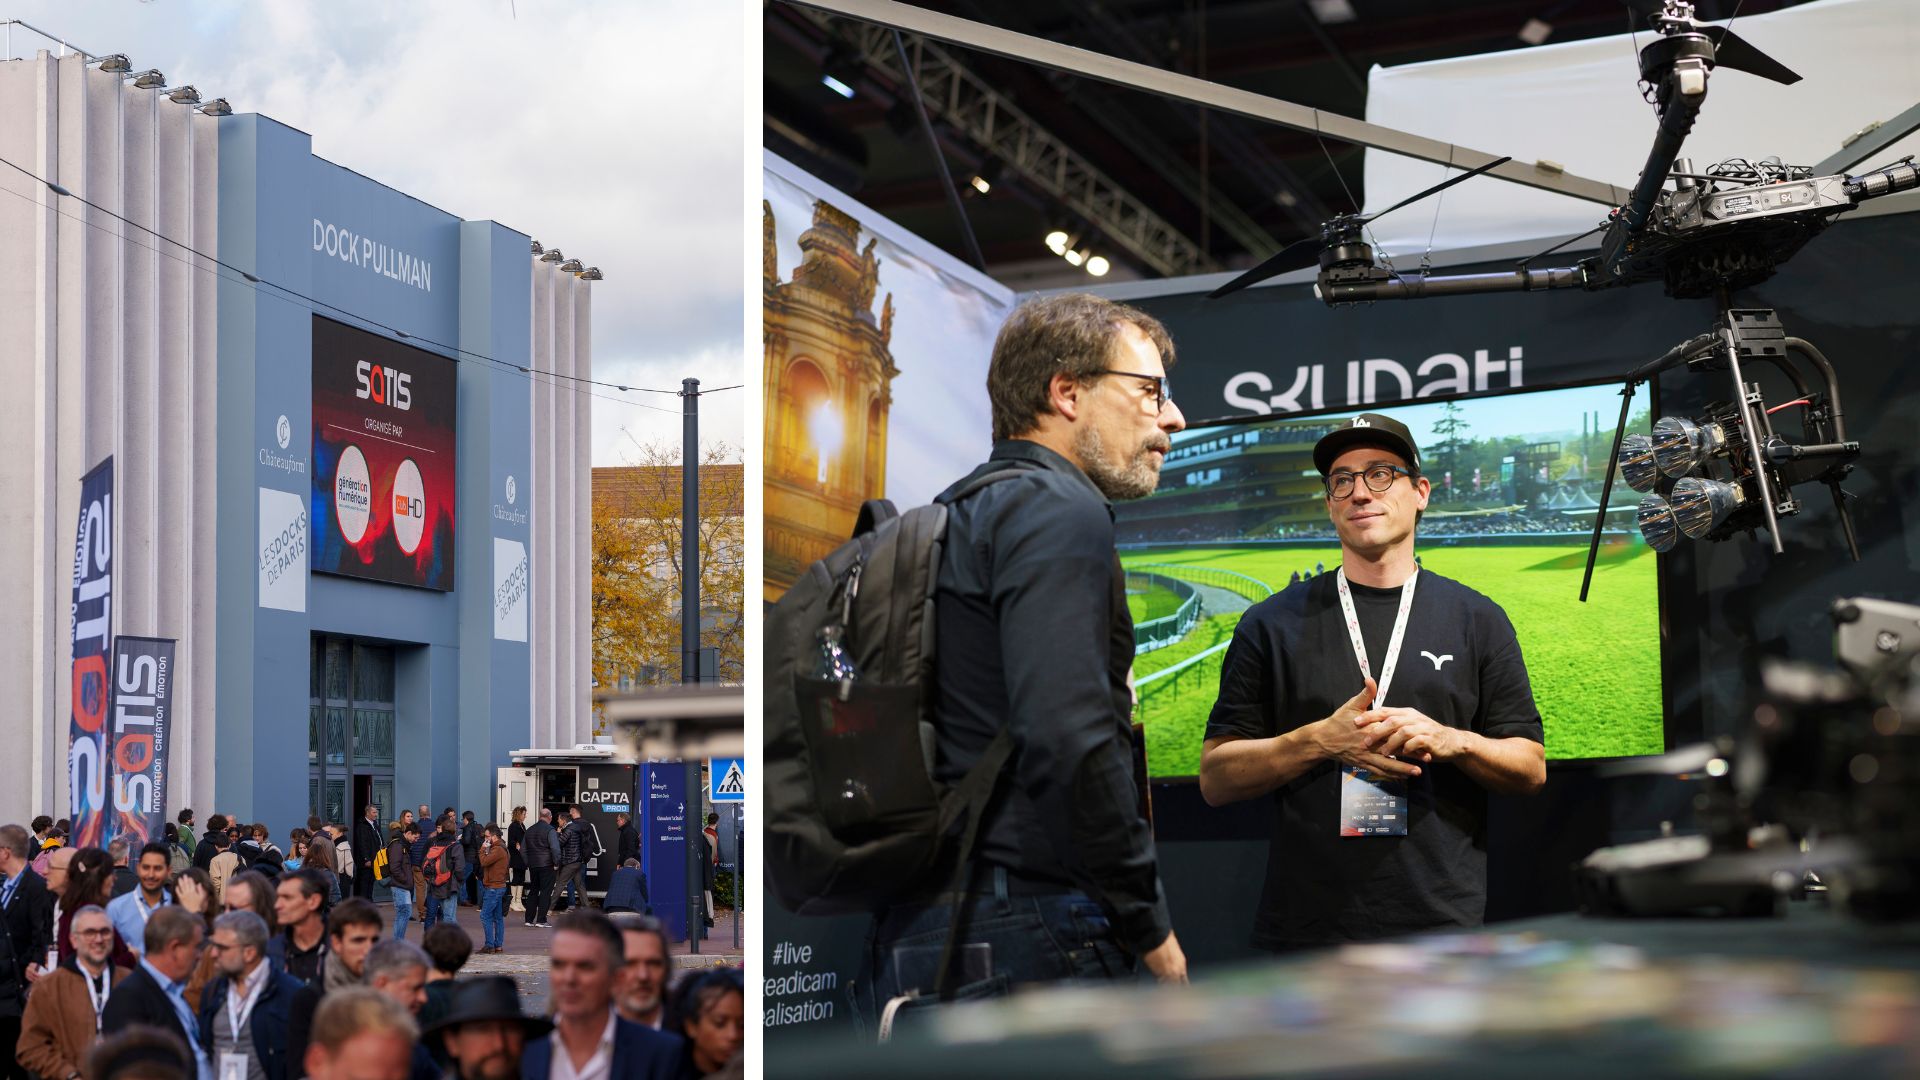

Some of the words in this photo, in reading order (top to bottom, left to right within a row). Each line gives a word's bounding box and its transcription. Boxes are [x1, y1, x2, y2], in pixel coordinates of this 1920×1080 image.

[313, 218, 360, 266] DOCK
[363, 238, 431, 292] PULLMAN
[356, 360, 411, 411] SATIS
[364, 417, 392, 435] ORGANISÉ
[392, 424, 403, 437] PAR
[407, 496, 423, 518] HD
[155, 656, 167, 699] ÉMOTION
[153, 705, 164, 752] CRÉATION
[153, 758, 162, 813] INNOVATION
[580, 791, 630, 804] CAPTA
[773, 941, 812, 965] #live
